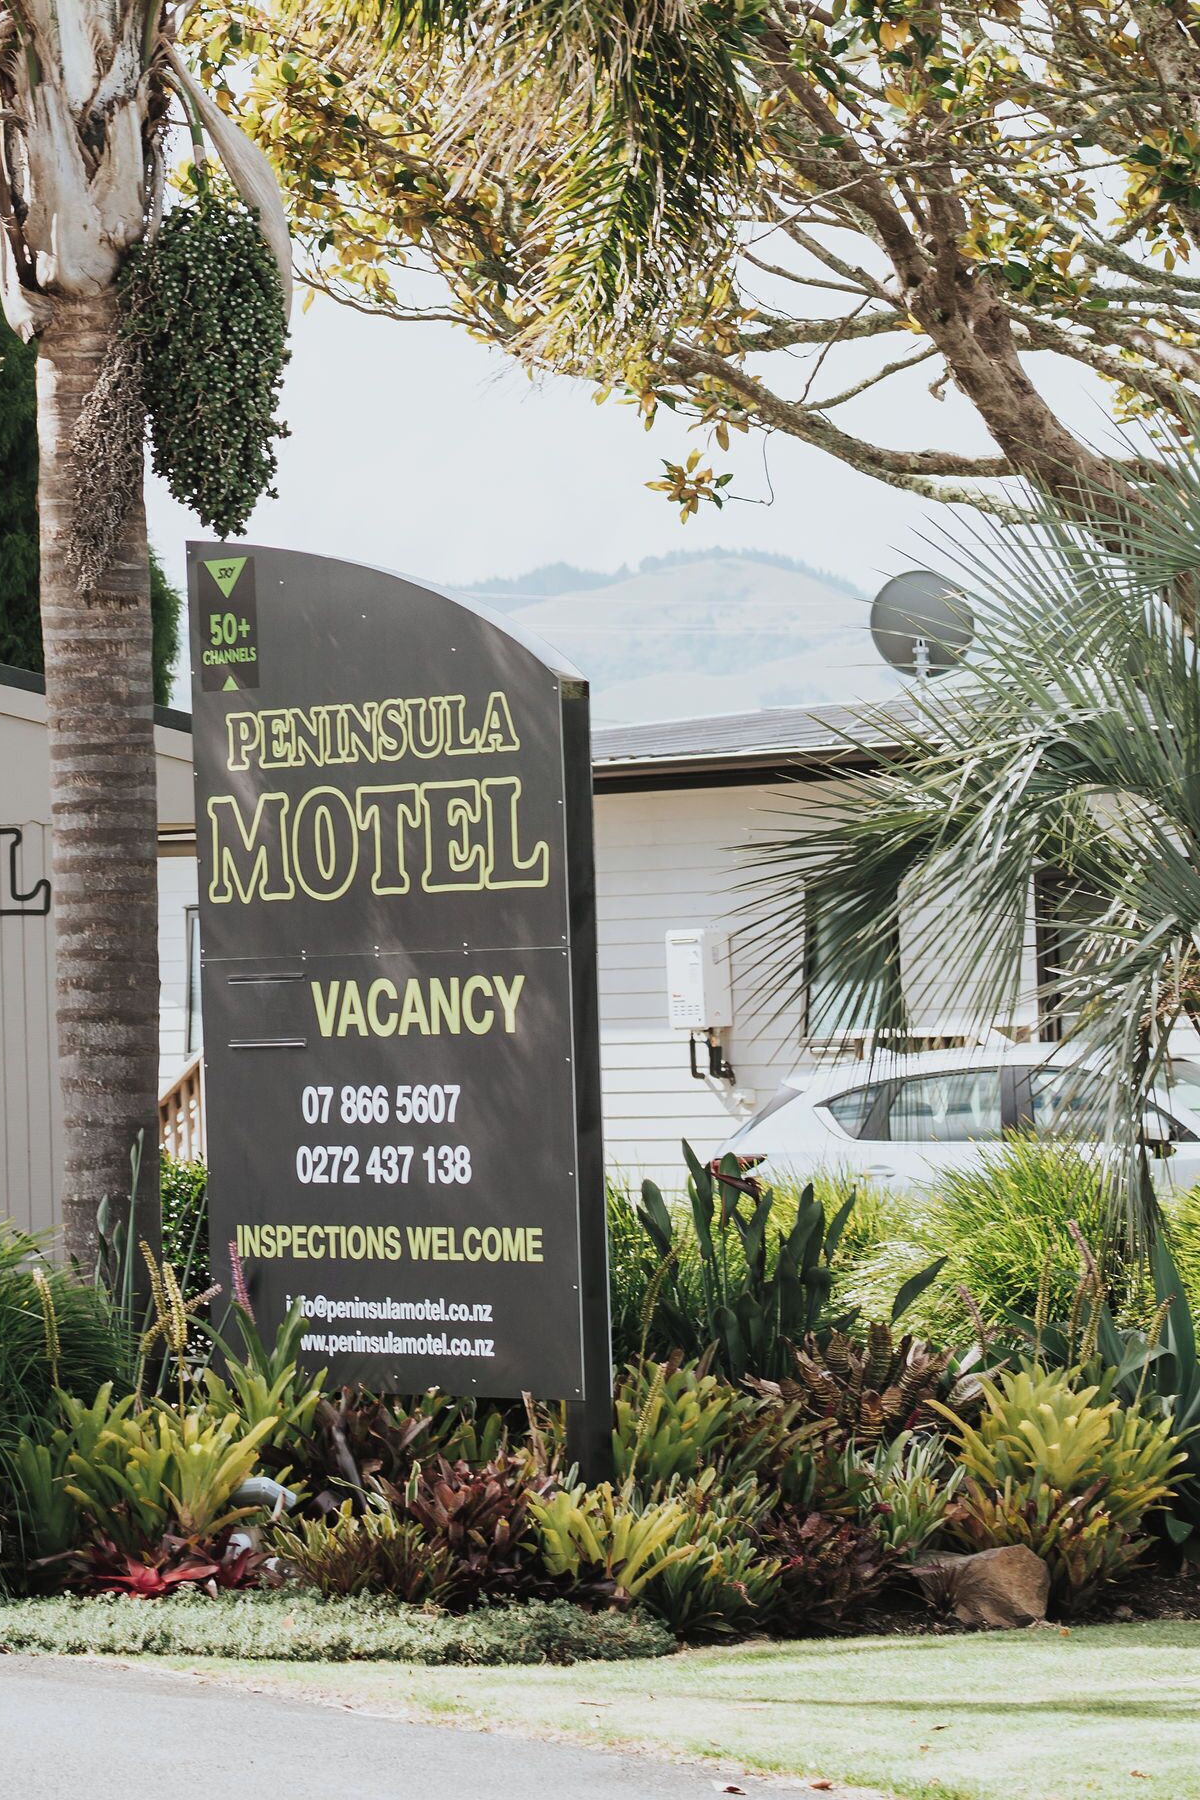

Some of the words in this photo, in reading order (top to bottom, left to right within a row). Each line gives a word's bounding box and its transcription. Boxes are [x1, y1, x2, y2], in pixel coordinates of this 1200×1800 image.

[209, 613, 250, 645] 50+
[203, 647, 256, 666] CHANNELS
[225, 692, 520, 771] PENINSULA
[207, 777, 549, 903] MOTEL
[311, 975, 525, 1037] VACANCY
[302, 1086, 333, 1124] 07
[340, 1085, 389, 1124] 866
[395, 1084, 461, 1123] 5607
[296, 1145, 360, 1184] 0272
[366, 1146, 414, 1184] 437
[422, 1145, 472, 1184] 138
[236, 1224, 401, 1260] INSPECTIONS
[406, 1226, 544, 1262] WELCOME
[285, 1294, 493, 1322] ifo@peninsulamotel.co.nz
[300, 1330, 495, 1357] ww.peninsulamotel.co.nz
